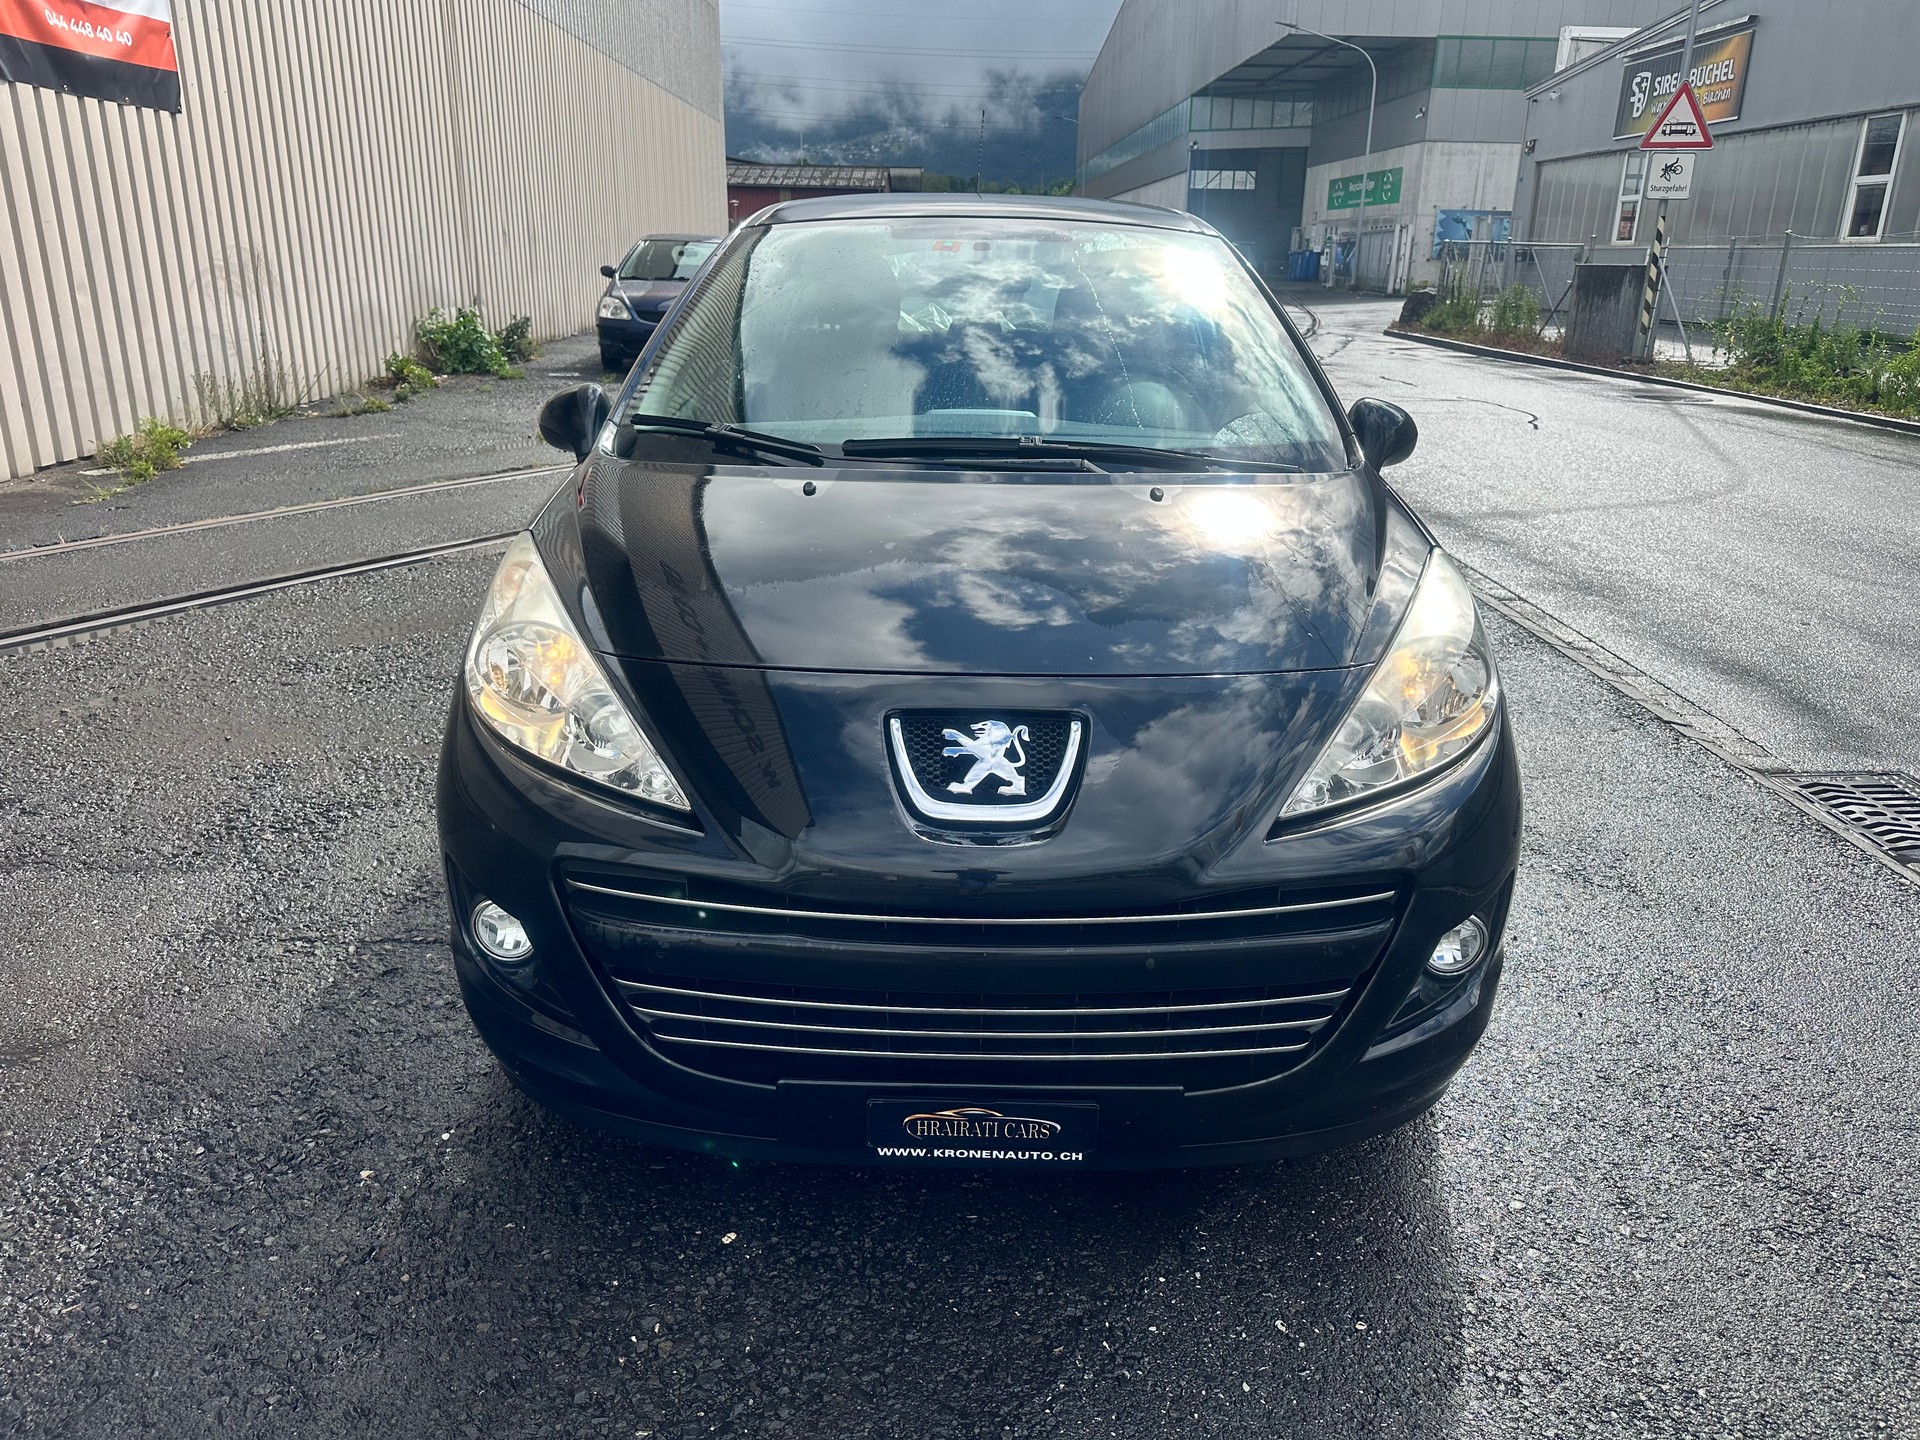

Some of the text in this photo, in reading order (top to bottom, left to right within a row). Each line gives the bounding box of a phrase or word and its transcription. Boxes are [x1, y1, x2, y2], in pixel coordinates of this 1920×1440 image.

[44, 9, 133, 47] 044 448 40 40
[1689, 58, 1735, 88] BÜCHEL
[1703, 87, 1731, 105] Blachen
[1650, 184, 1687, 194] Sturzgefahr!
[1004, 1121, 1050, 1140] CARS
[877, 1147, 1083, 1161] WWW.KRONENAUTO.CH
